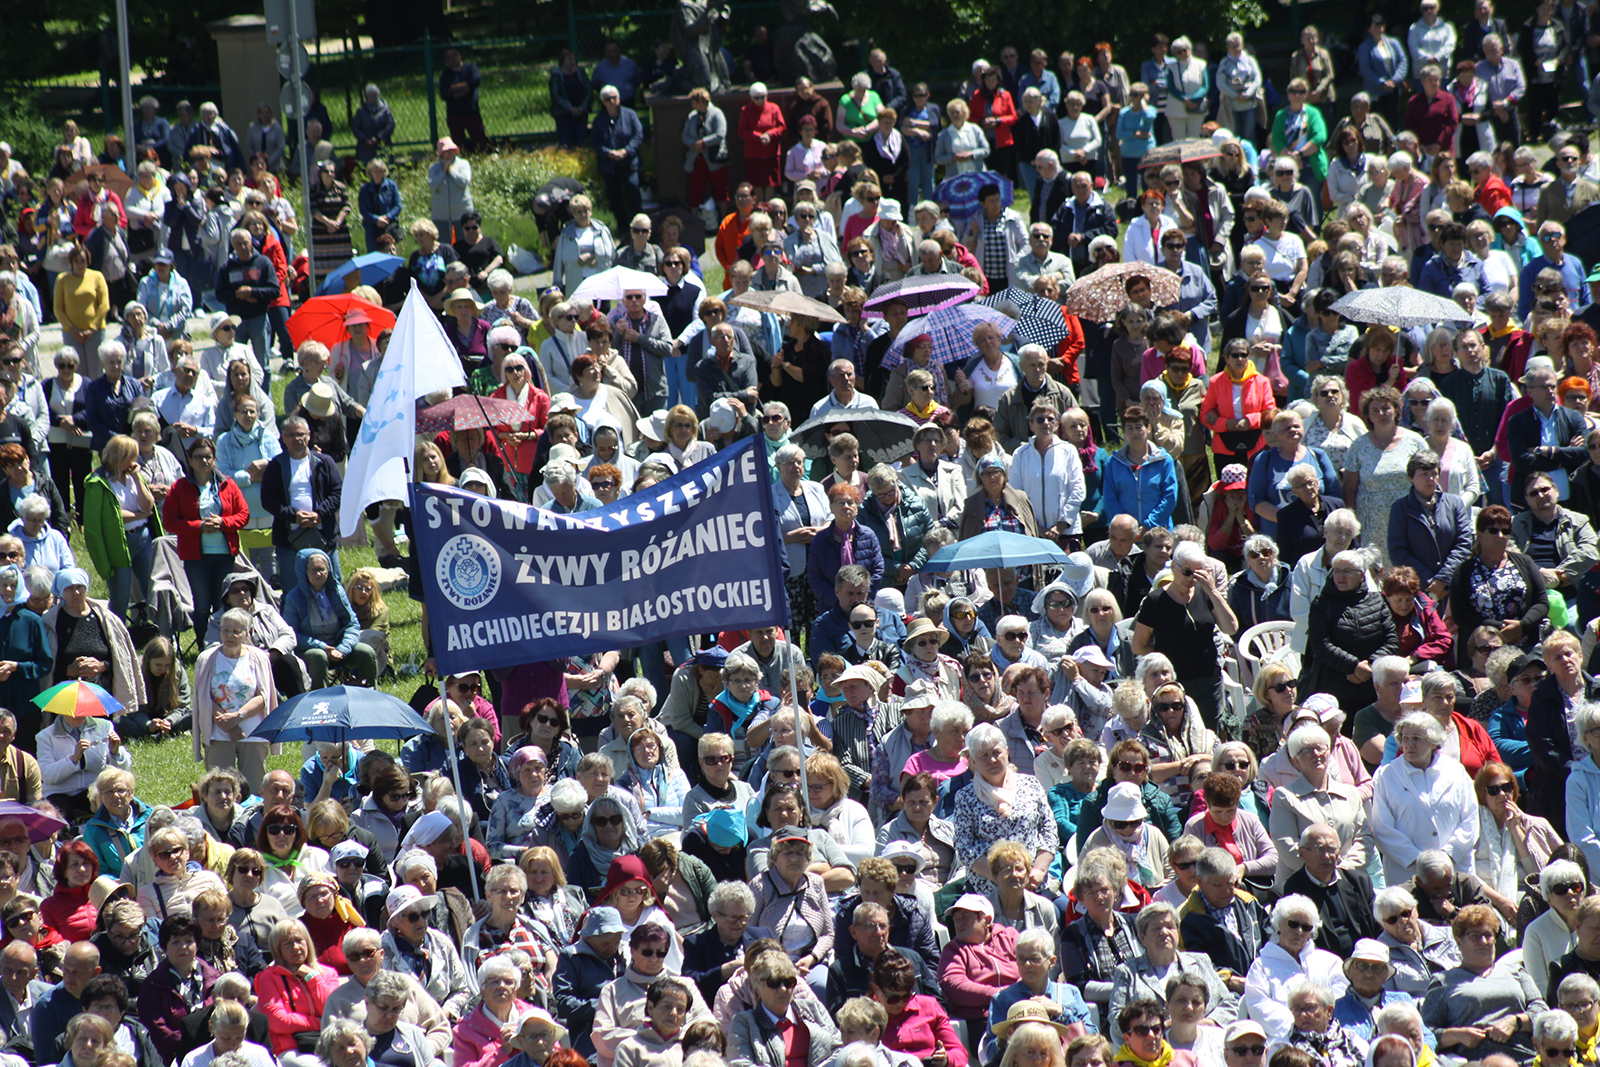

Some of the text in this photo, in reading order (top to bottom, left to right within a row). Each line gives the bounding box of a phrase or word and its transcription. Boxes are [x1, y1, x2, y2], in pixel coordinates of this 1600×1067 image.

[514, 511, 765, 586] ŻYWY RÓŻANIEC
[447, 578, 772, 652] ARCHIDIECEZJI BIAŁOSTOCKIEJ
[464, 570, 498, 606] RÓŻANIEC
